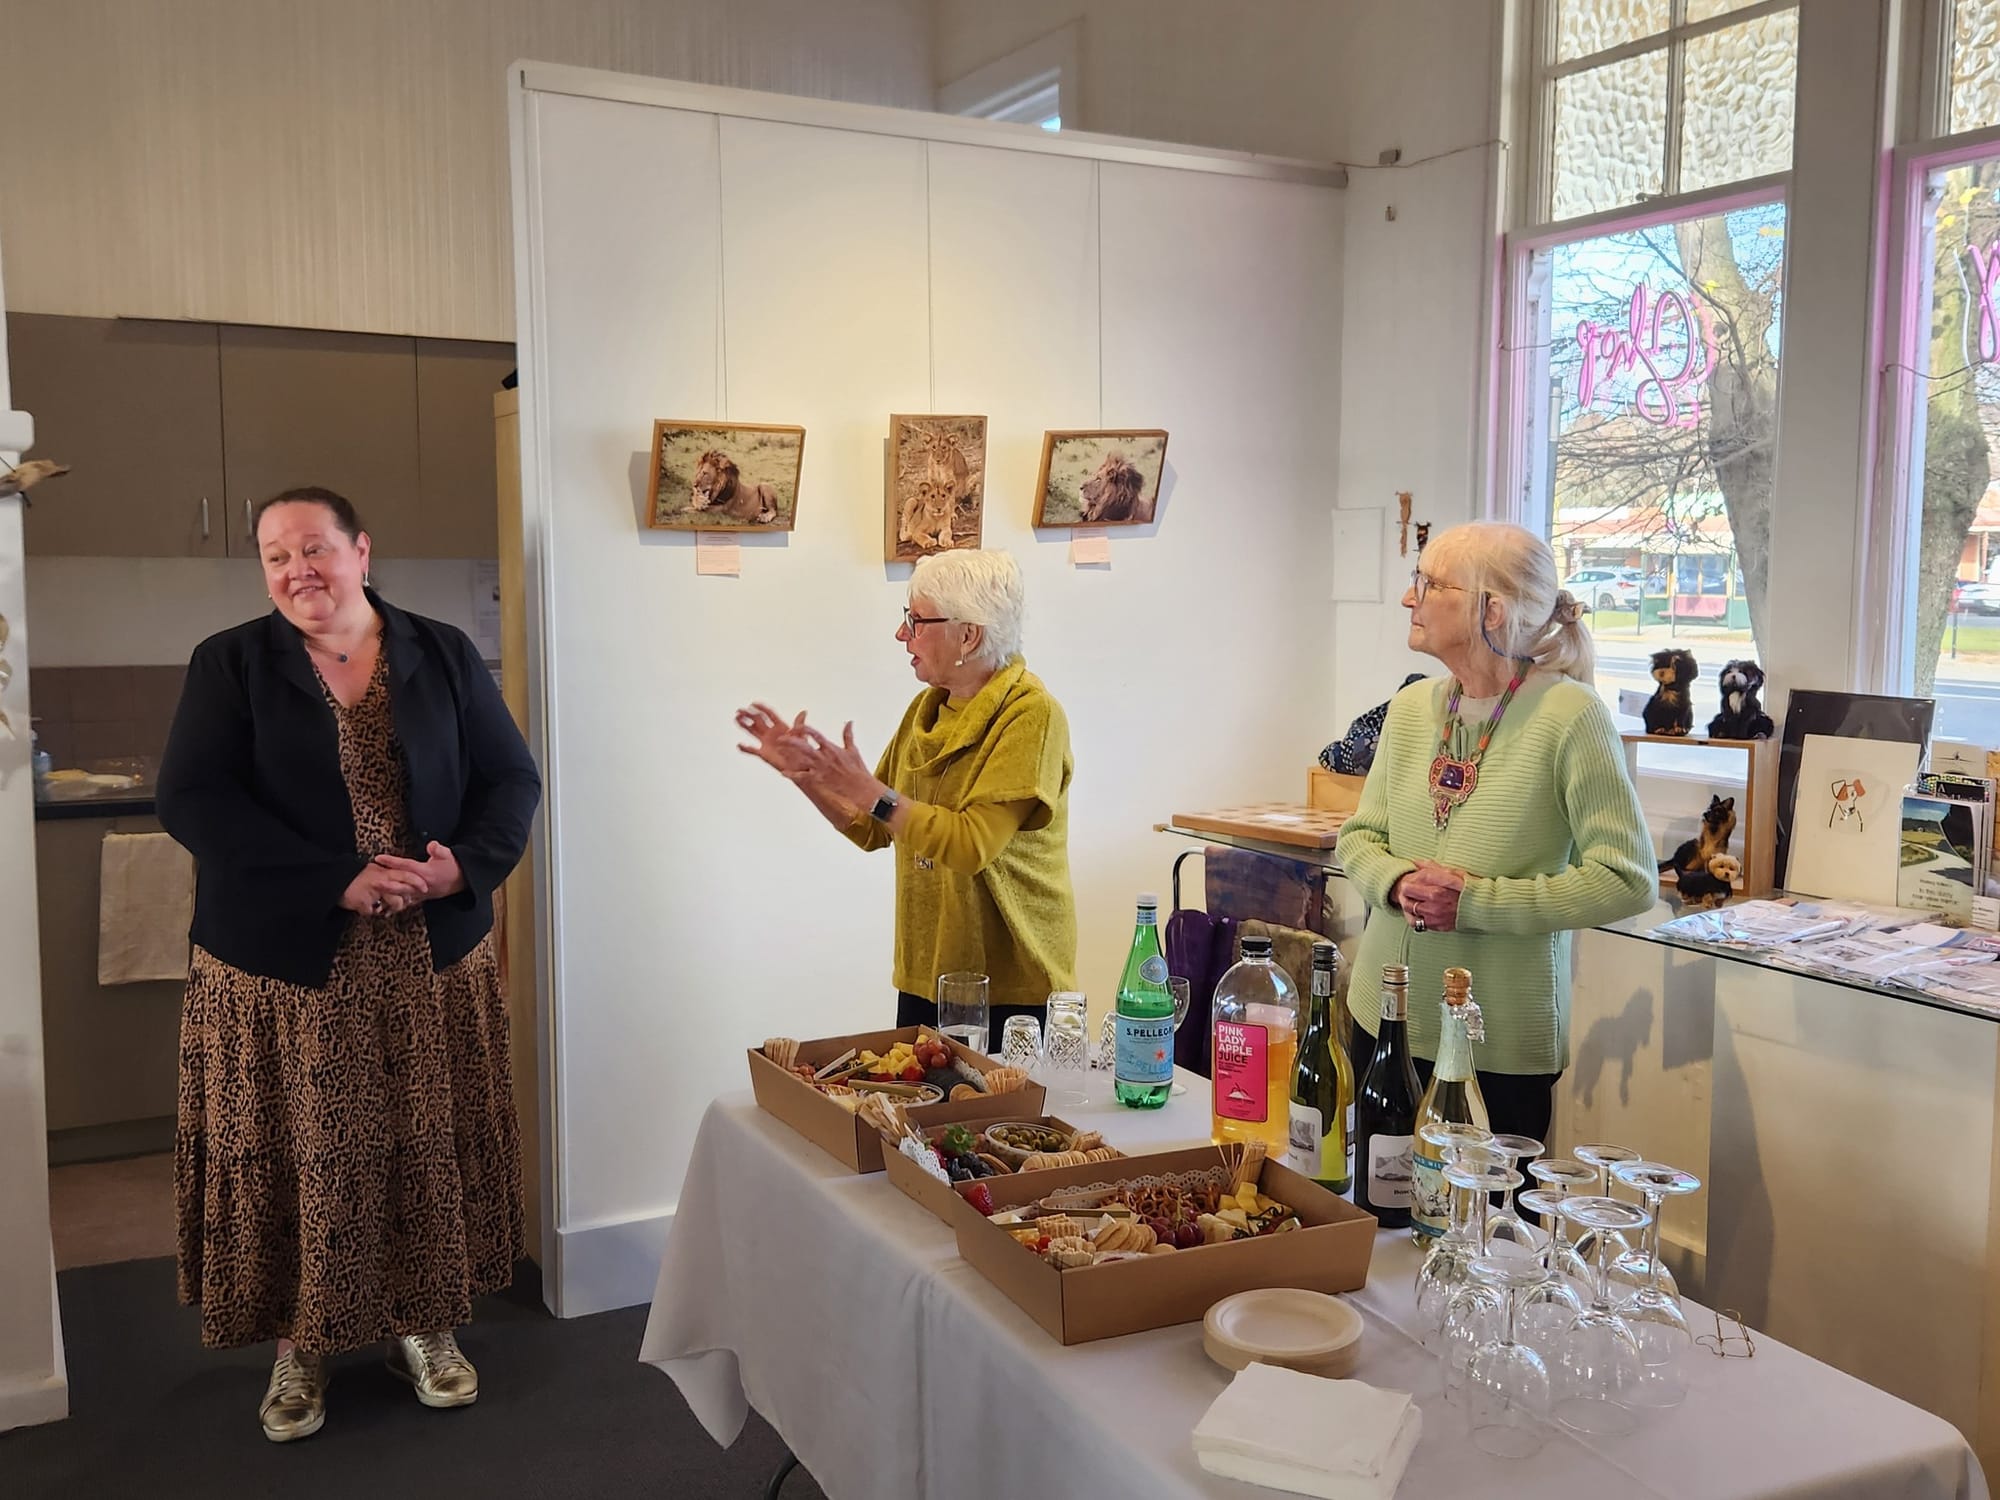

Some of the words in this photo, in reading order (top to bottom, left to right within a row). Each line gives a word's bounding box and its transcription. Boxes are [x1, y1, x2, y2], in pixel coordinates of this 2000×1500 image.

[1218, 1024, 1244, 1038] PINK
[1218, 1034, 1247, 1046] LADY
[1218, 1043, 1253, 1056] APPLE
[1218, 1051, 1248, 1064] JUICE
